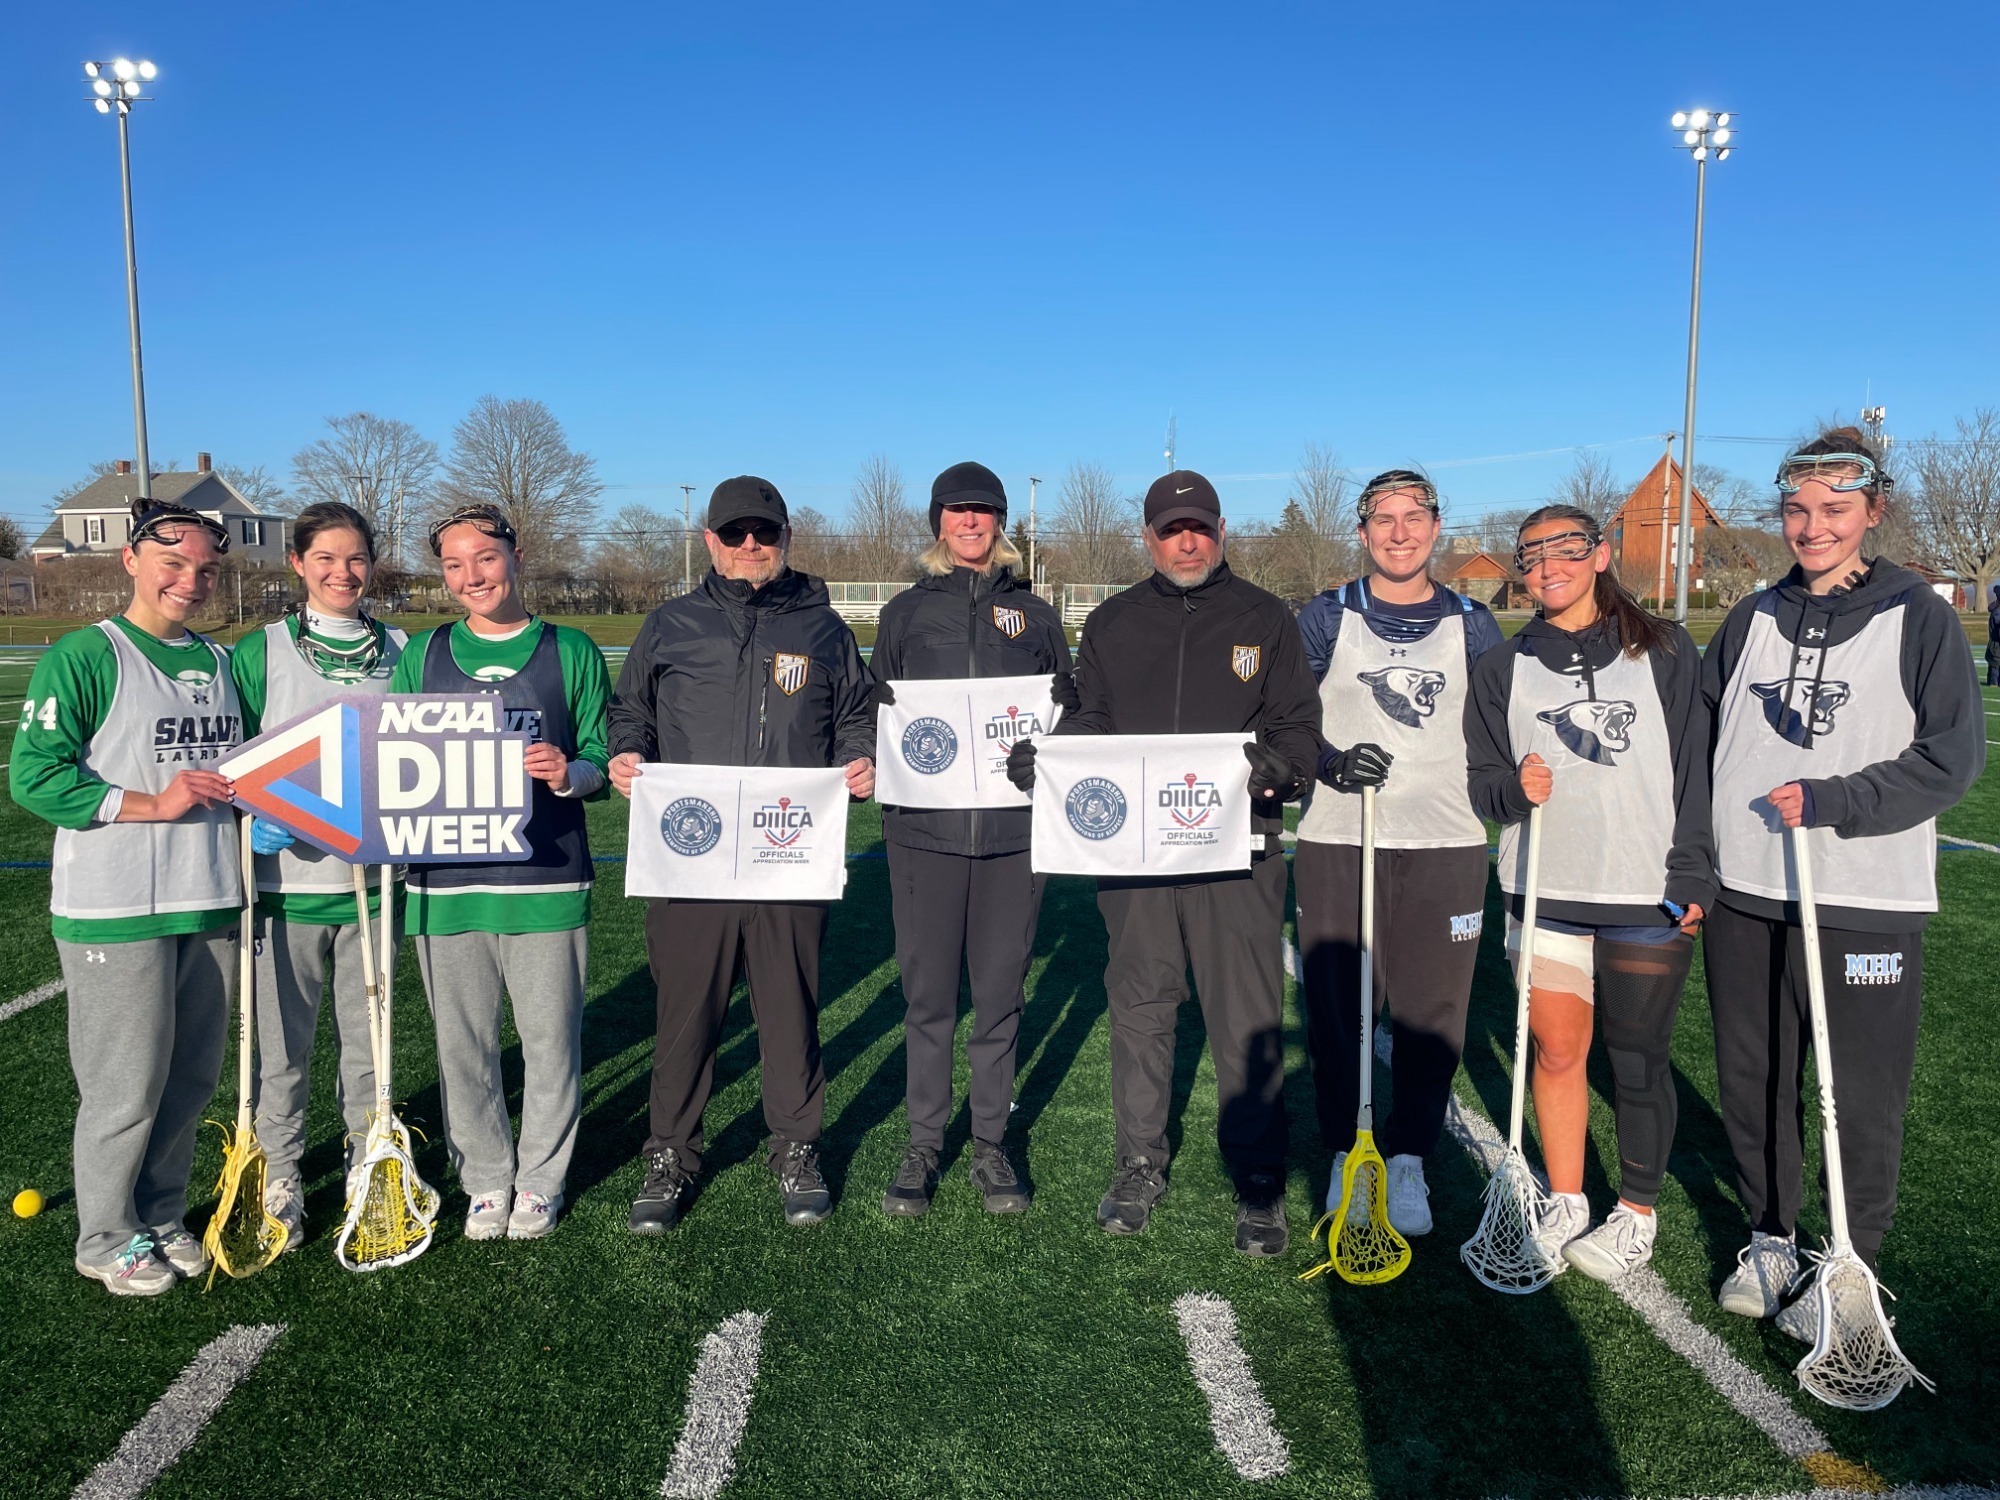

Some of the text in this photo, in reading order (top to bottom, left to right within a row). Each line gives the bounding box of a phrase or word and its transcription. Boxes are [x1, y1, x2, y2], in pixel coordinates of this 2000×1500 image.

[21, 697, 57, 732] 34
[904, 719, 955, 741] SPORTSMANSHIP
[985, 718, 1044, 739] DIIICA
[156, 749, 231, 764] LACRO
[377, 740, 524, 809] DIII
[1068, 779, 1125, 804] SPORTSMANSHIP
[1159, 789, 1222, 807] DIIICA
[664, 799, 720, 823] SPORTSMANSHIP
[753, 812, 813, 828] DIIICA
[380, 814, 524, 856] WEEK
[1845, 952, 1903, 976] MHC
